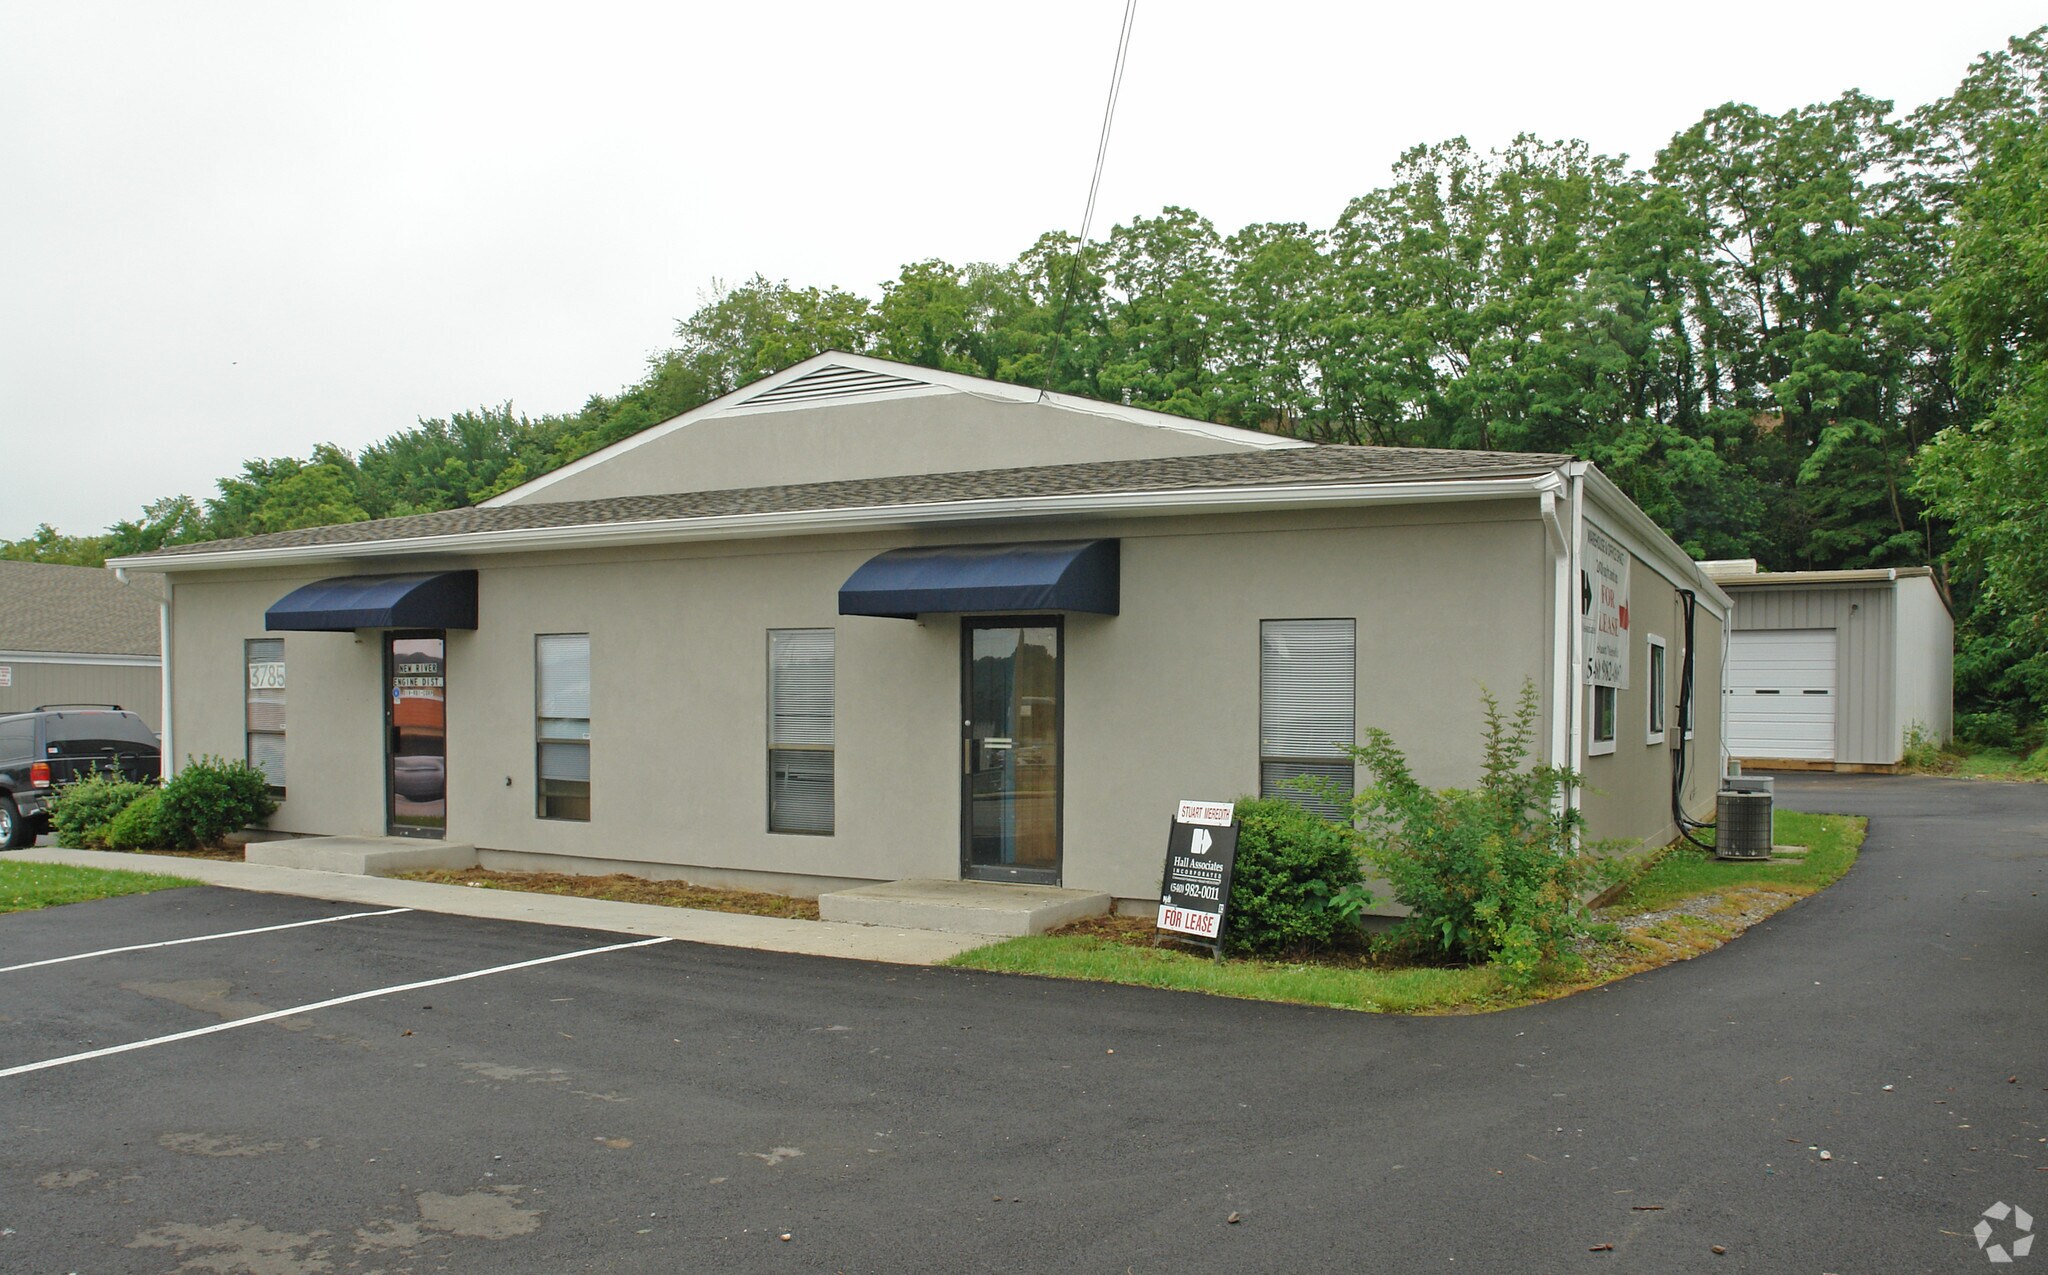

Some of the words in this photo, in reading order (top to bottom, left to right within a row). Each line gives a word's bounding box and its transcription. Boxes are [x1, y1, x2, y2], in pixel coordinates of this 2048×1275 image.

[1601, 584, 1614, 608] FOR
[1598, 611, 1618, 637] LEASE
[250, 664, 285, 687] 3785
[399, 664, 411, 673] NEW
[416, 663, 437, 673] RIVER
[394, 678, 418, 687] ENGINE
[1181, 805, 1203, 818] STUART
[1204, 807, 1231, 820] MEREDITH
[1173, 856, 1189, 868] Hall
[1189, 858, 1224, 872] Associates
[1173, 867, 1222, 879] INCORPORATED
[1170, 882, 1184, 894] (540)
[1184, 883, 1220, 901] 982-0011
[1164, 909, 1183, 928] FOR
[1185, 912, 1214, 933] LEASE
